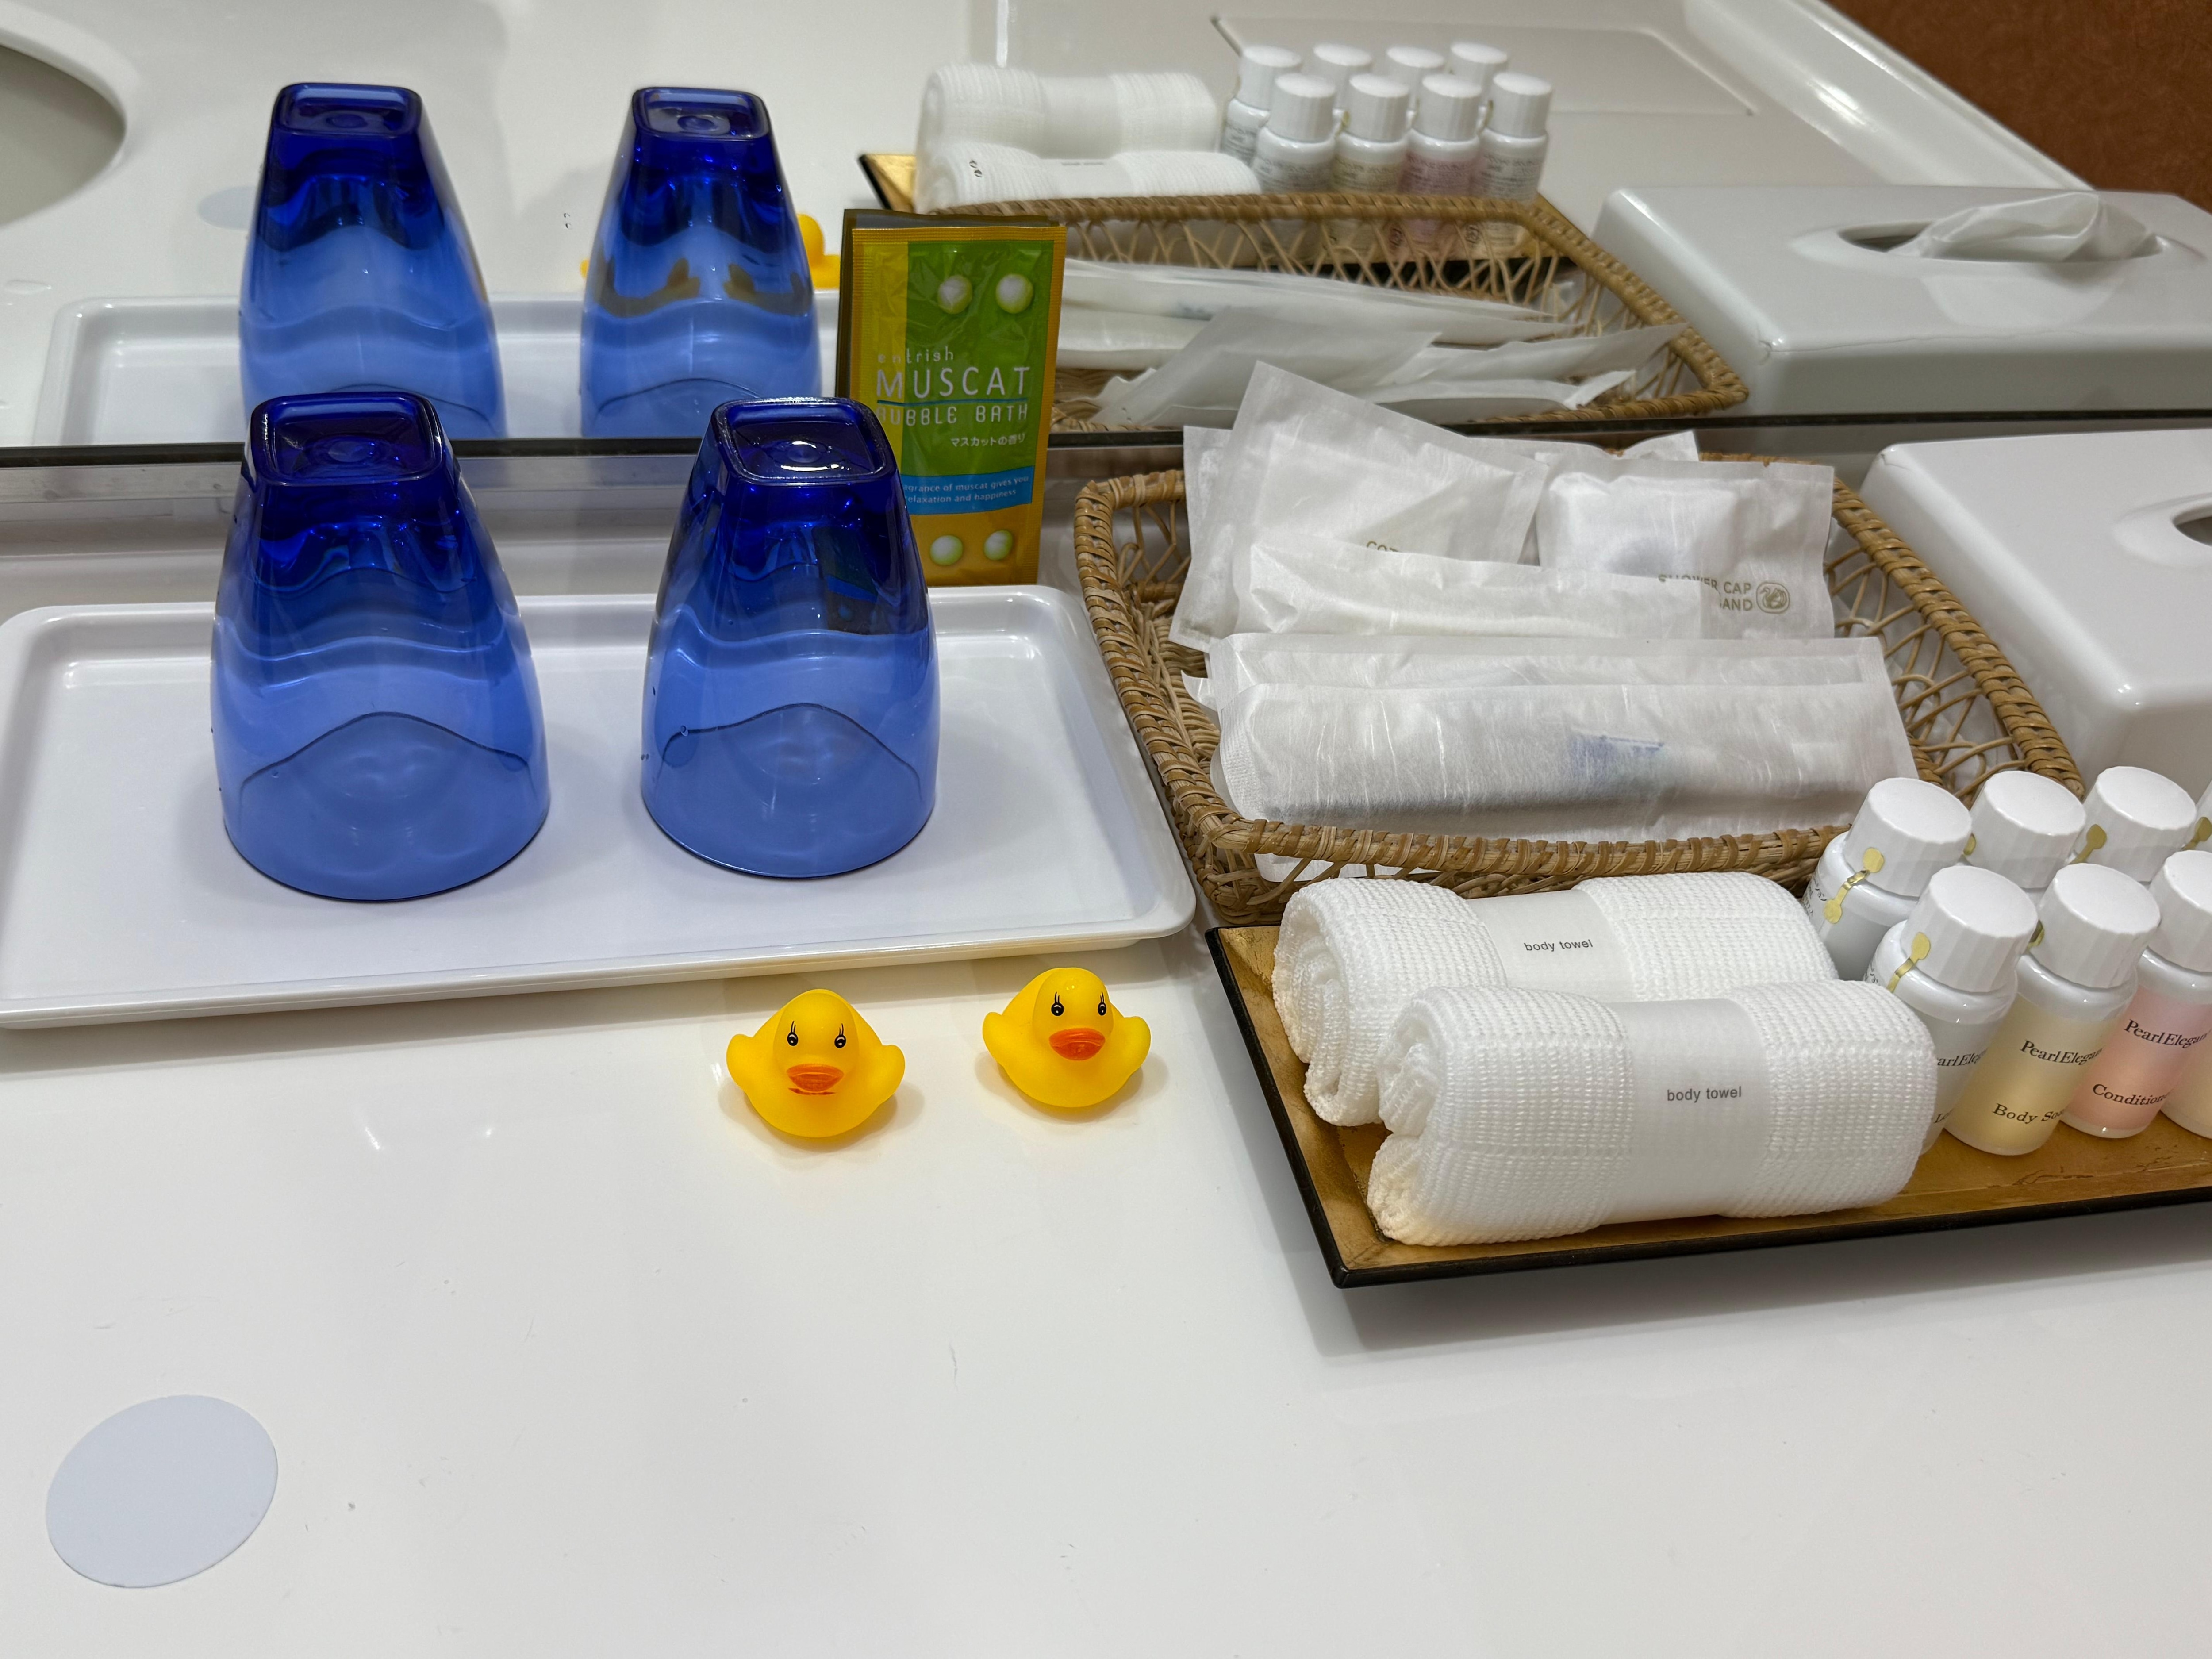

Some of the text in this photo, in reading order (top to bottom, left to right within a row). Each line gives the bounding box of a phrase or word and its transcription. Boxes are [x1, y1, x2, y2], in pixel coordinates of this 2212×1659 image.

[878, 346, 953, 364] entrish
[876, 367, 1030, 399] MUSCAT
[975, 403, 1028, 423] BATH
[951, 433, 1026, 447] マスカットの香り
[903, 484, 940, 493] agrance
[956, 483, 988, 491] muscat
[991, 479, 1012, 490] gives
[1014, 475, 1029, 484] you
[905, 488, 1017, 503] elaxation and happiness
[1724, 581, 1752, 595] CAP
[1720, 598, 1753, 611] AND
[1524, 939, 1593, 952] body towel
[1667, 1085, 1742, 1103] body towel
[1992, 1103, 2039, 1125] Body
